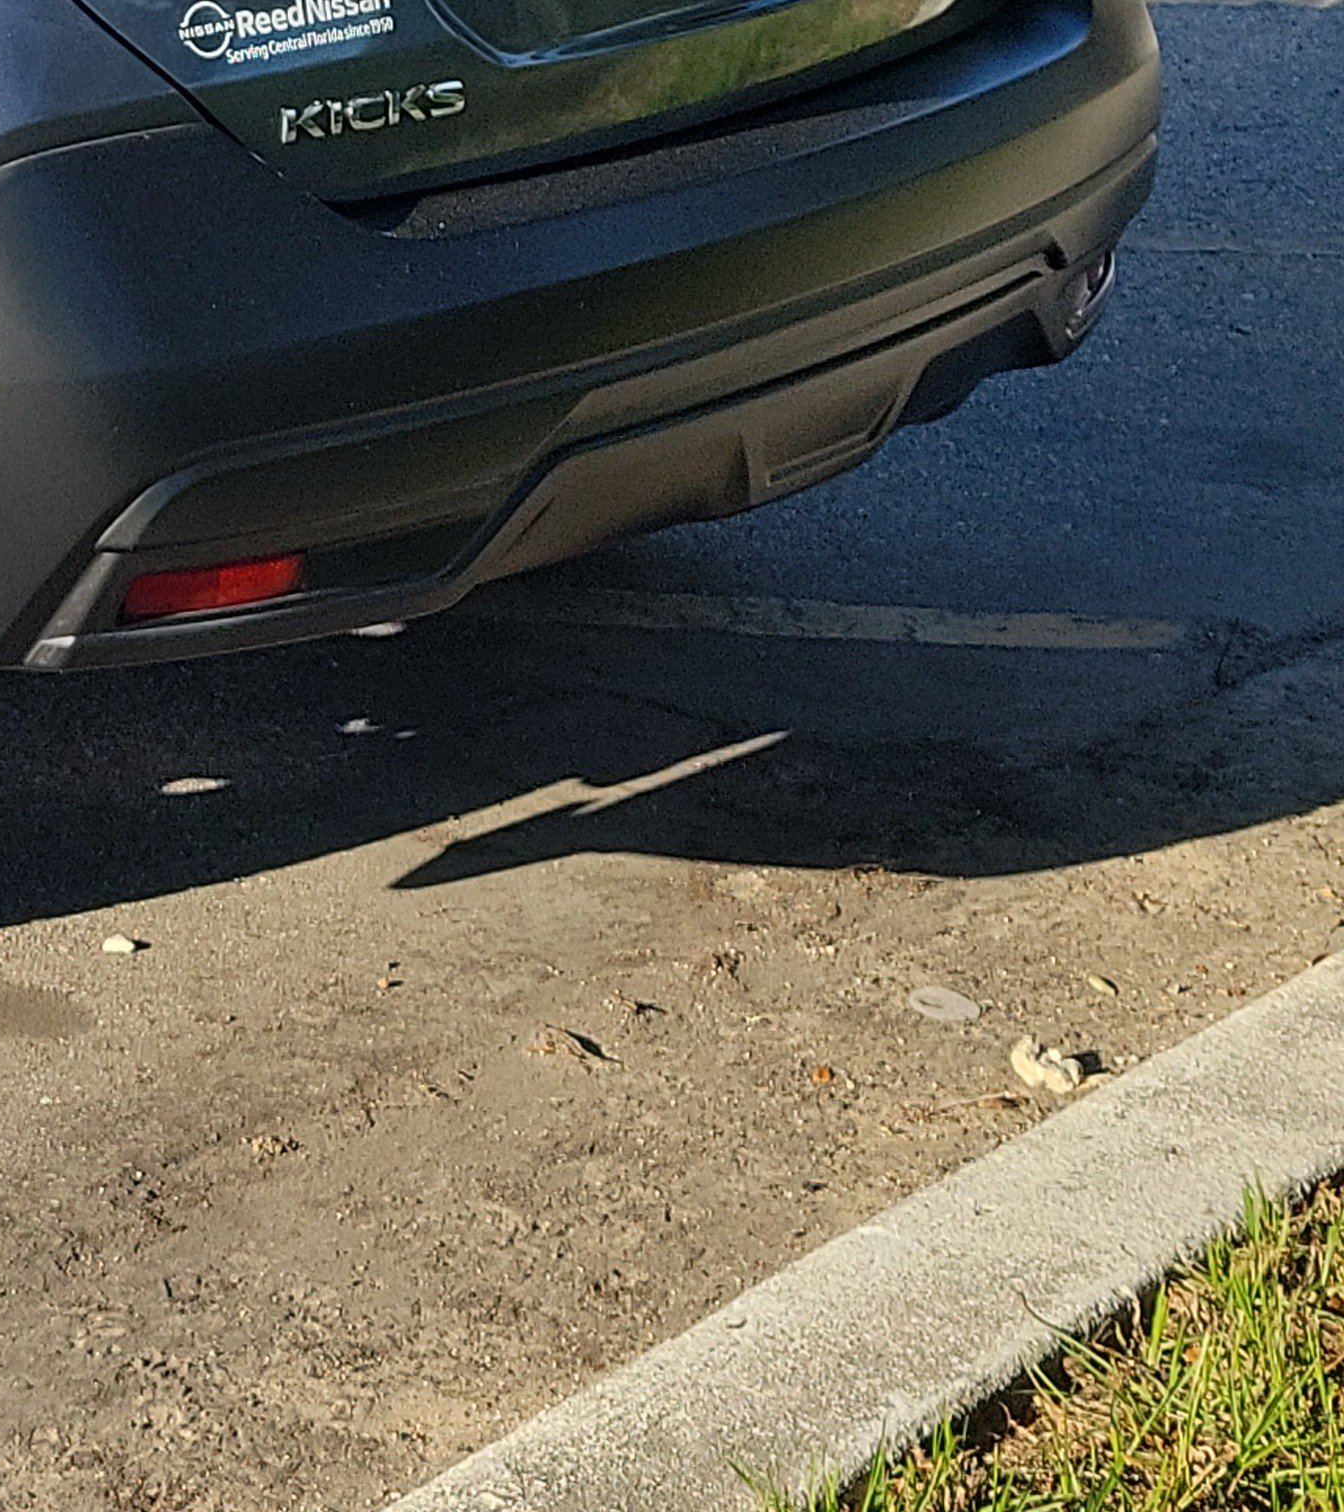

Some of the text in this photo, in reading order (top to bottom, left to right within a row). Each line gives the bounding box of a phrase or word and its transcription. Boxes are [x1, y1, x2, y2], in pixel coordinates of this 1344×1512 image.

[178, 18, 235, 41] NISSAN
[225, 43, 269, 65] Serving
[268, 33, 307, 56] Central
[307, 28, 344, 48] Florida
[280, 78, 466, 145] KICKS
